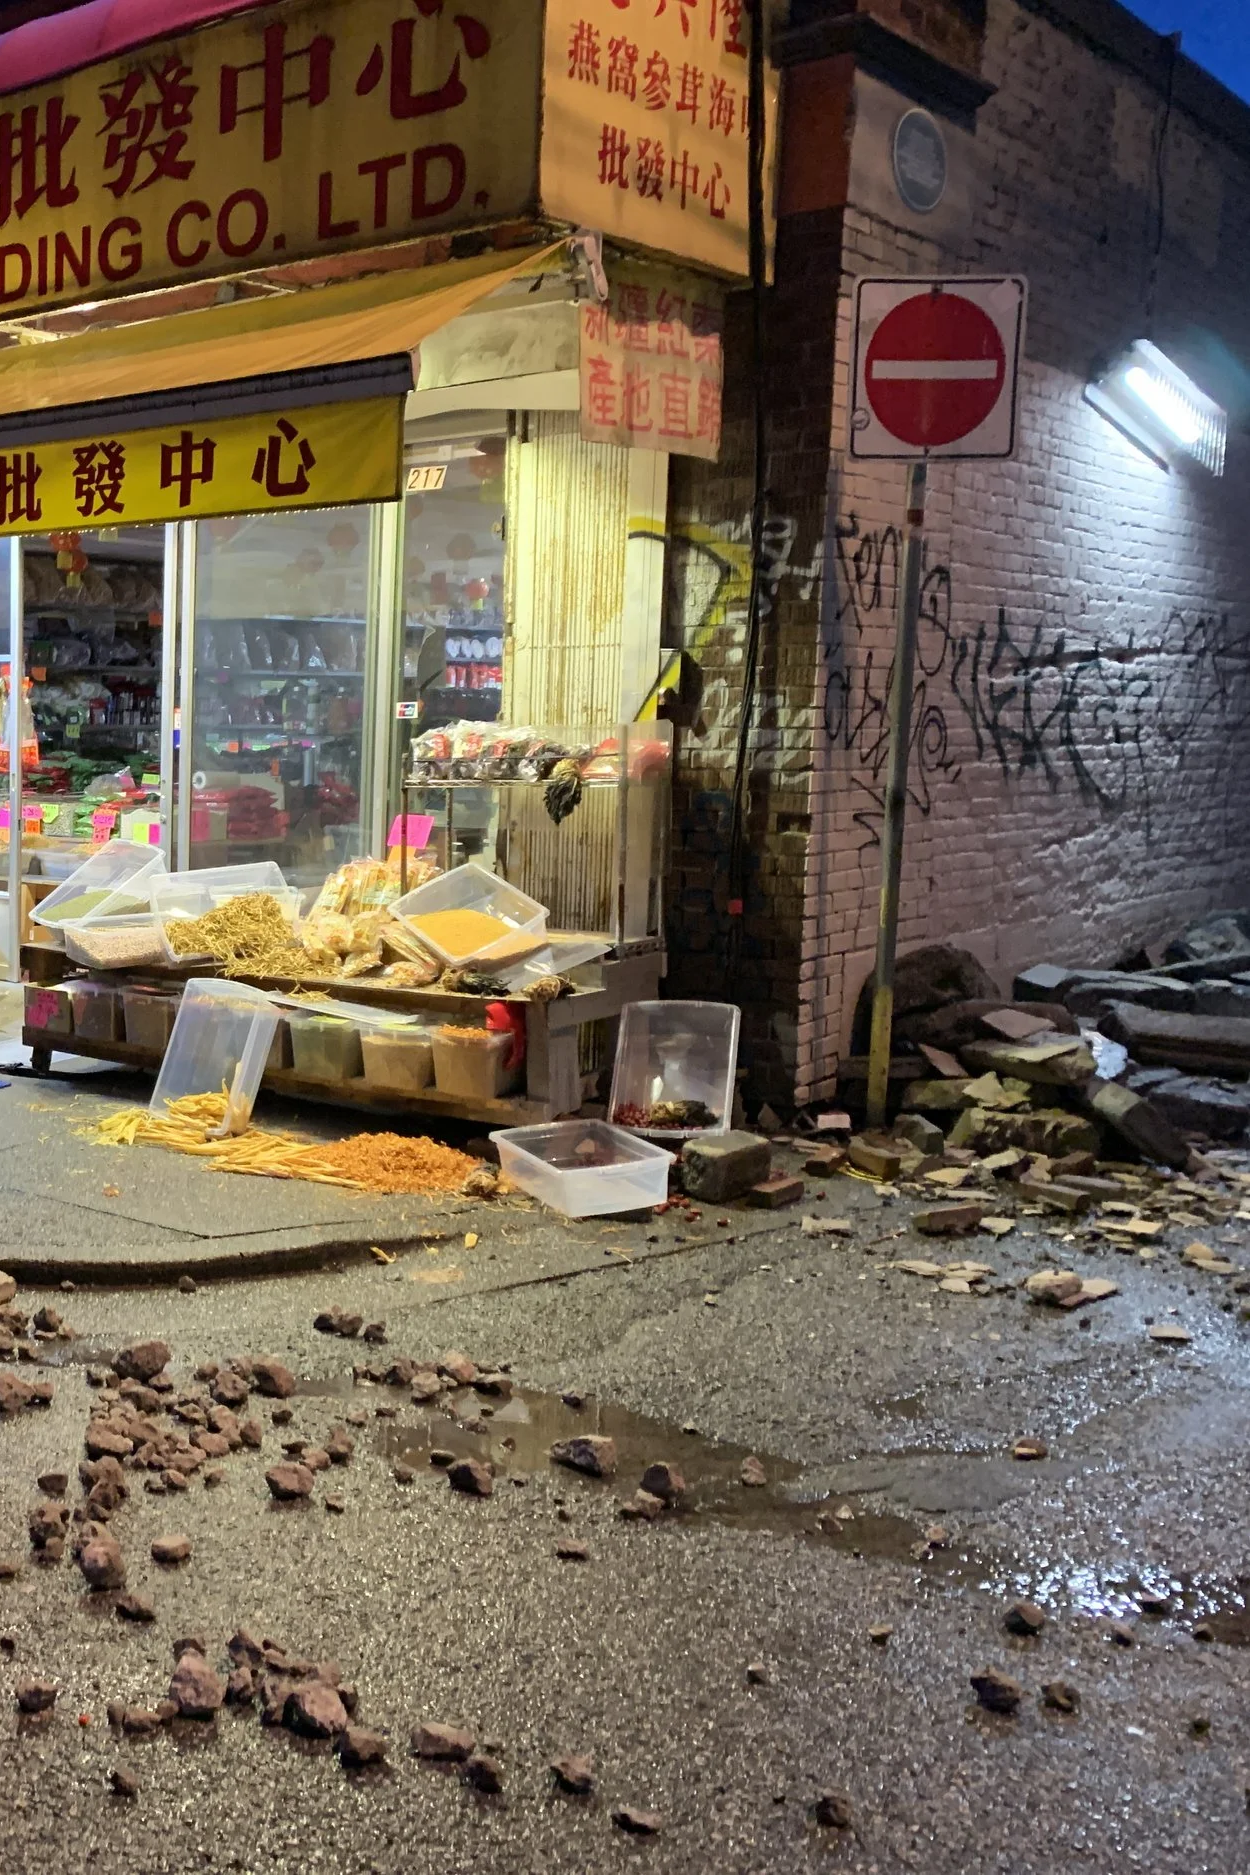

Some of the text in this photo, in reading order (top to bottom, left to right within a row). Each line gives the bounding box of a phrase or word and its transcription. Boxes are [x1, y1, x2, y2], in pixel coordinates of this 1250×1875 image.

[568, 18, 749, 137] 燕窩參茸海
[166, 188, 286, 267] CO.
[318, 142, 490, 241] LTD.
[598, 122, 731, 220] 批發中心
[408, 467, 445, 489] 217
